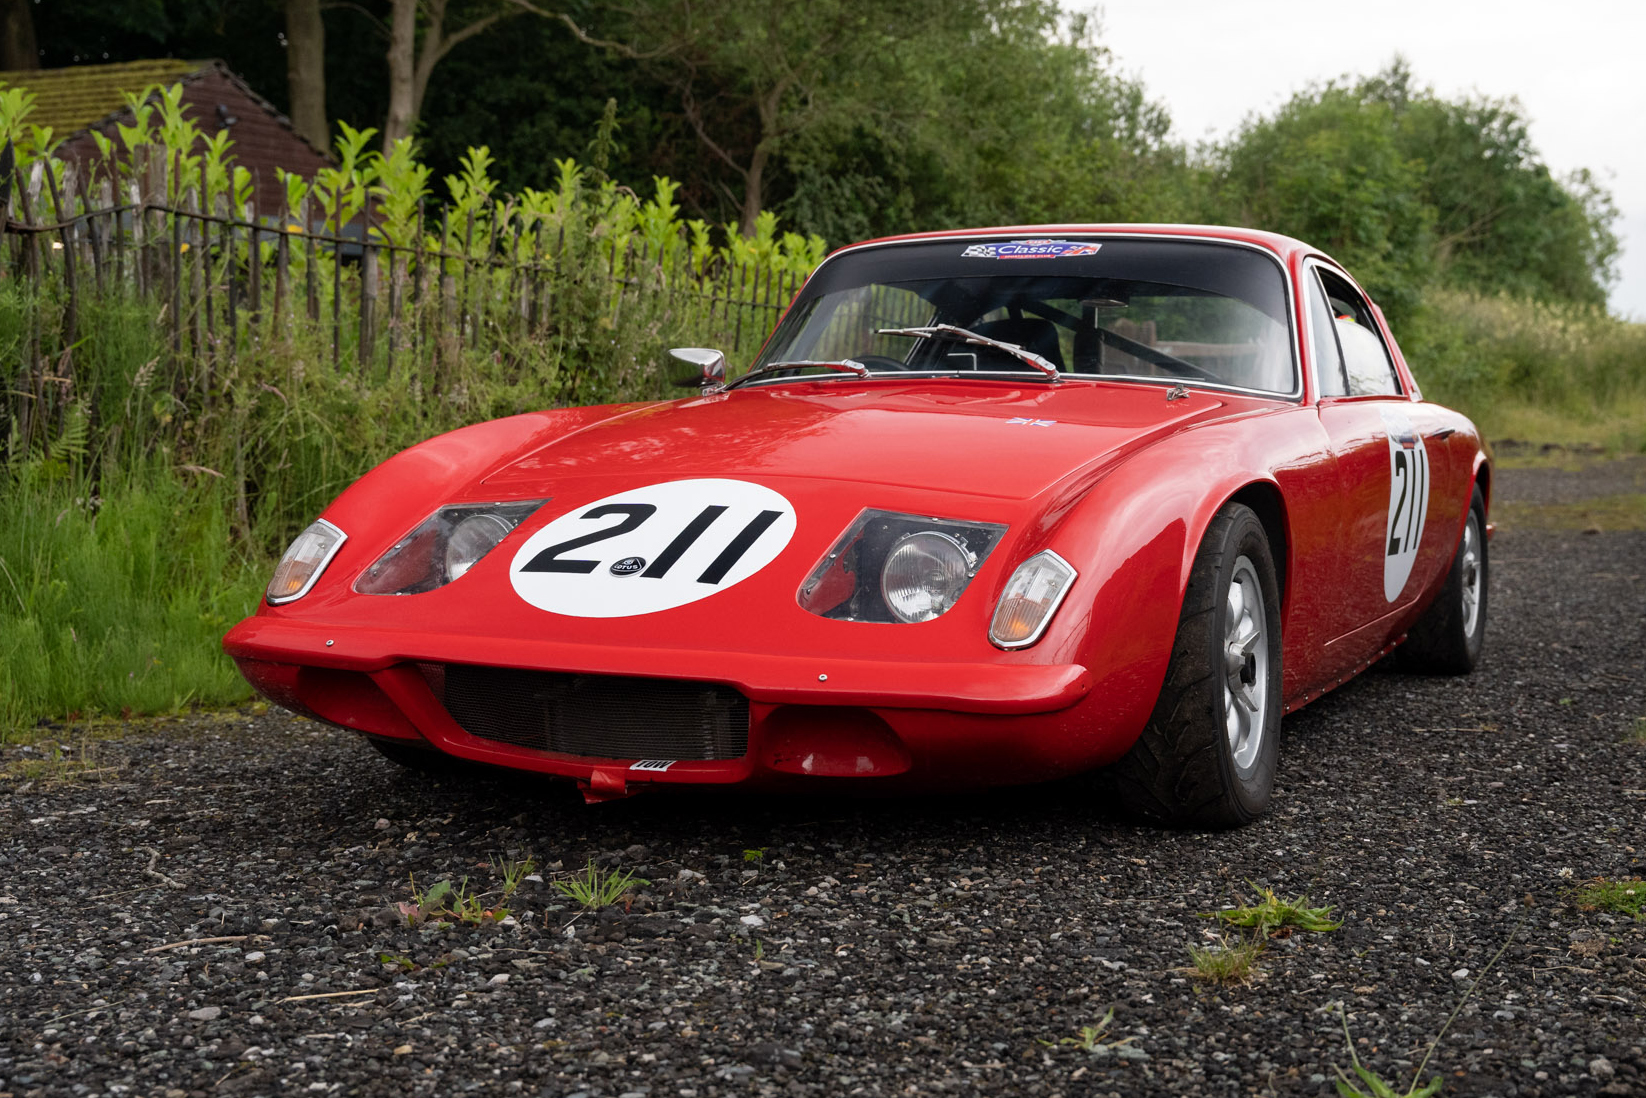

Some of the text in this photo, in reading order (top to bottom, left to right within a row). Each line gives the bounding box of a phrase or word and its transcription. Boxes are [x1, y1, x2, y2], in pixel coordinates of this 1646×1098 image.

[998, 245, 1063, 254] Classic
[1387, 449, 1424, 556] 211
[519, 503, 785, 585] 211
[635, 760, 673, 769] TOW
